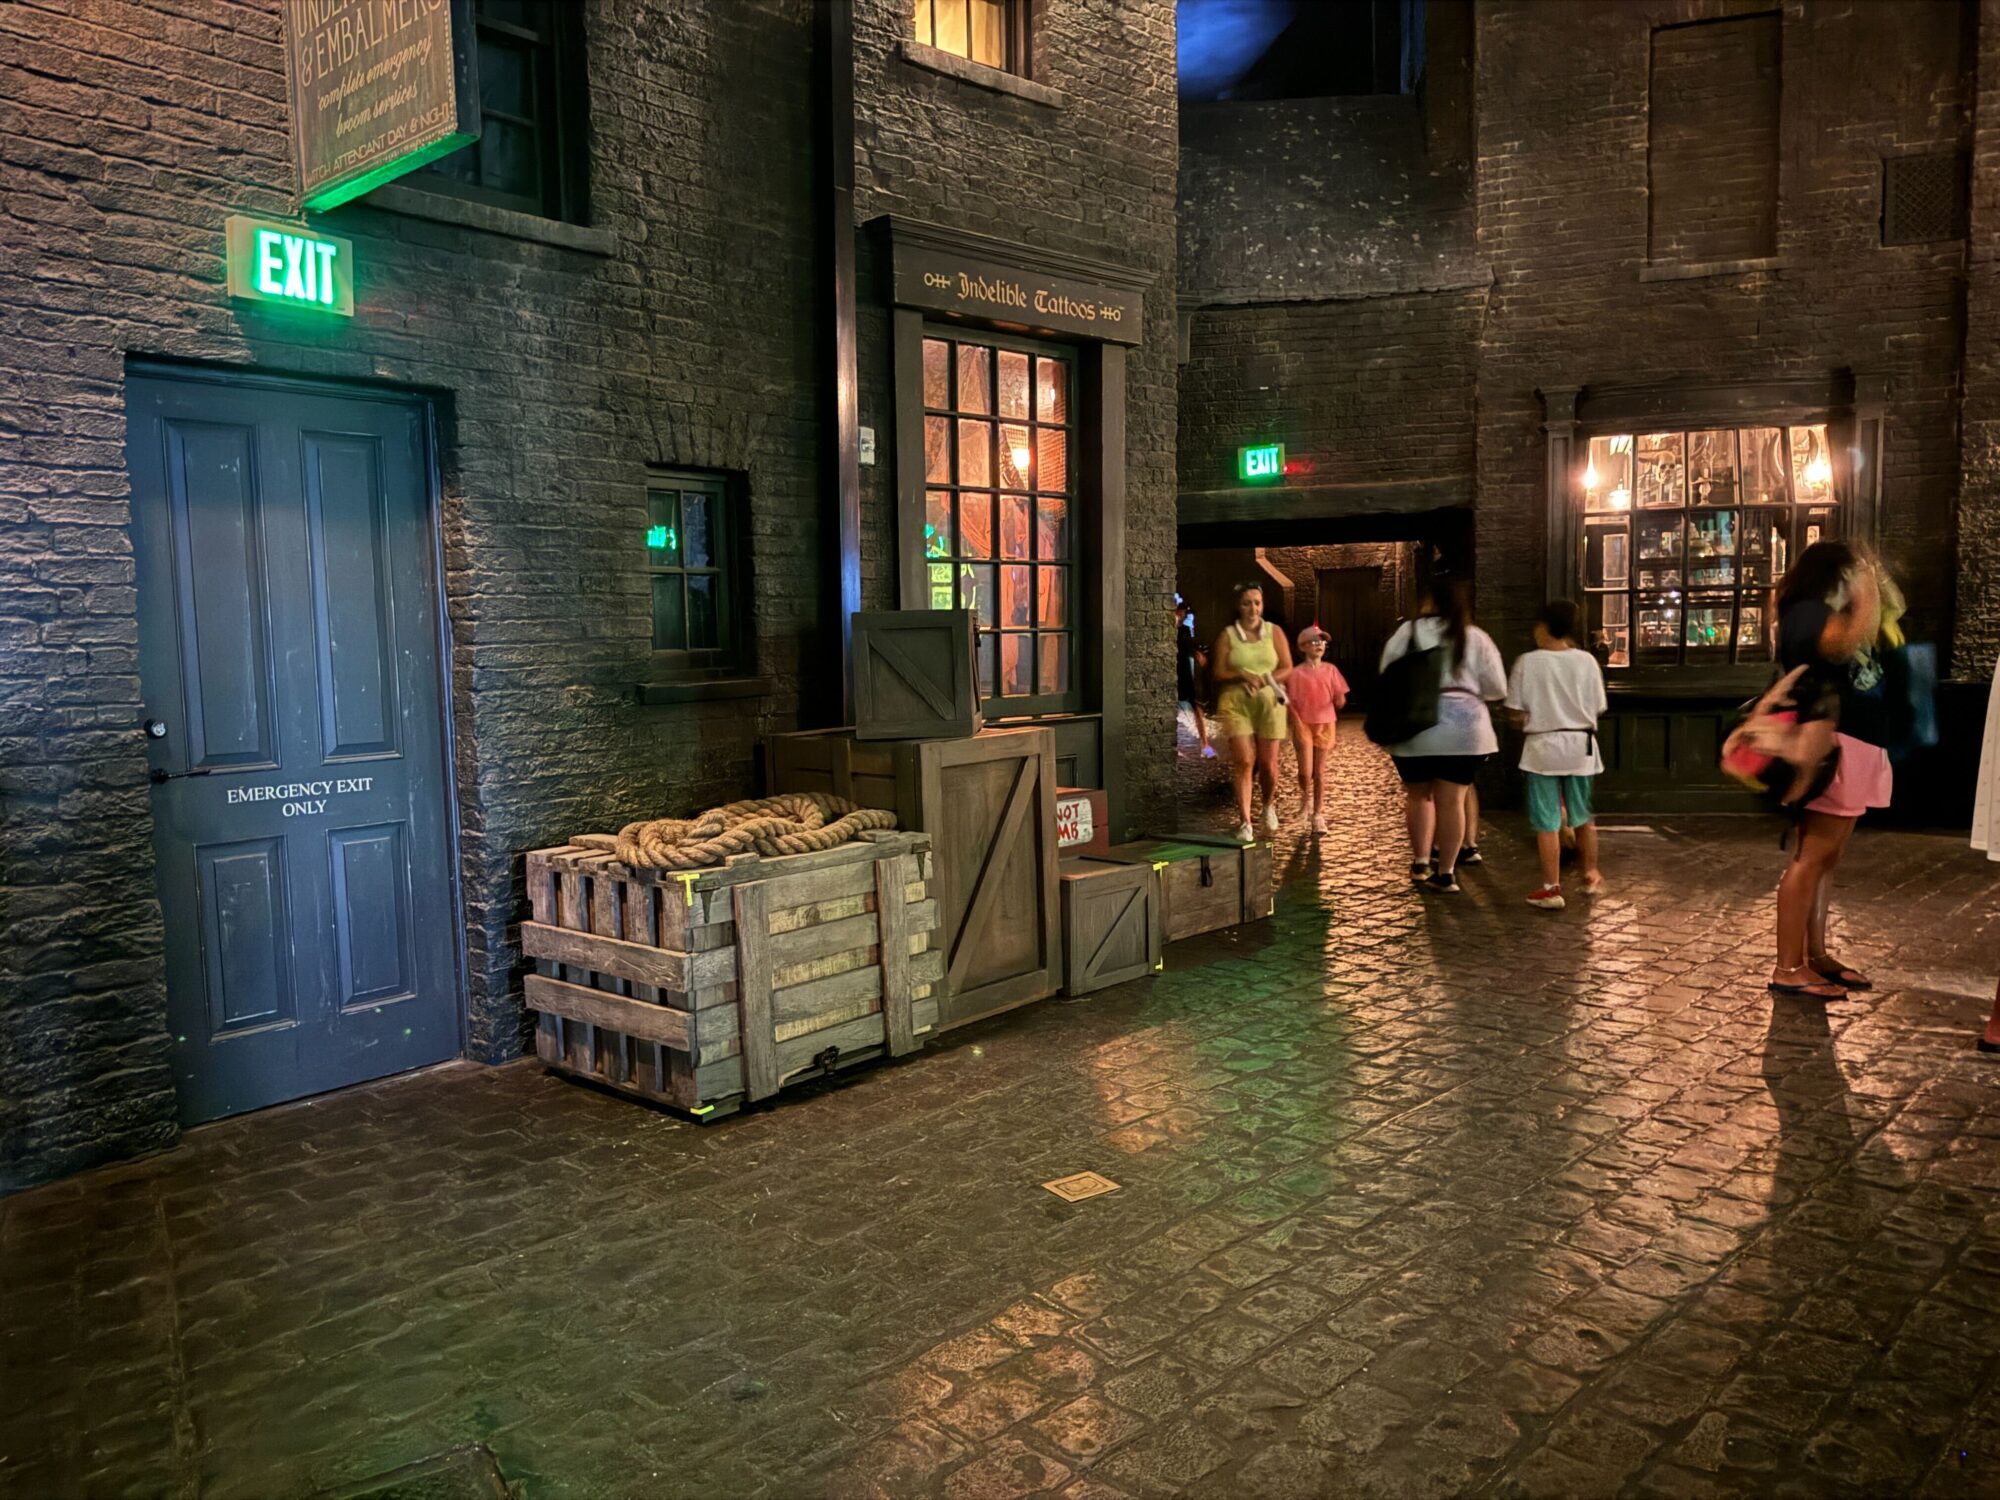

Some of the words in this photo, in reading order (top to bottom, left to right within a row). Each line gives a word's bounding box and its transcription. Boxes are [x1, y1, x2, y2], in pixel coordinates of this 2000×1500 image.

[302, 46, 313, 87] &
[316, 0, 441, 79] EMBALME
[317, 69, 366, 111] complete
[367, 34, 432, 83] emergency
[336, 113, 372, 138] broom
[373, 80, 417, 118] services
[388, 122, 408, 146] DAY
[410, 117, 419, 133] &
[258, 228, 337, 305] EXIT
[957, 272, 1028, 308] Indelible
[1034, 289, 1096, 321] Tattoos
[1246, 447, 1279, 476] EXIT
[227, 780, 334, 804] EMERGENCY
[336, 777, 373, 793] EXIT
[282, 799, 327, 817] ONLY
